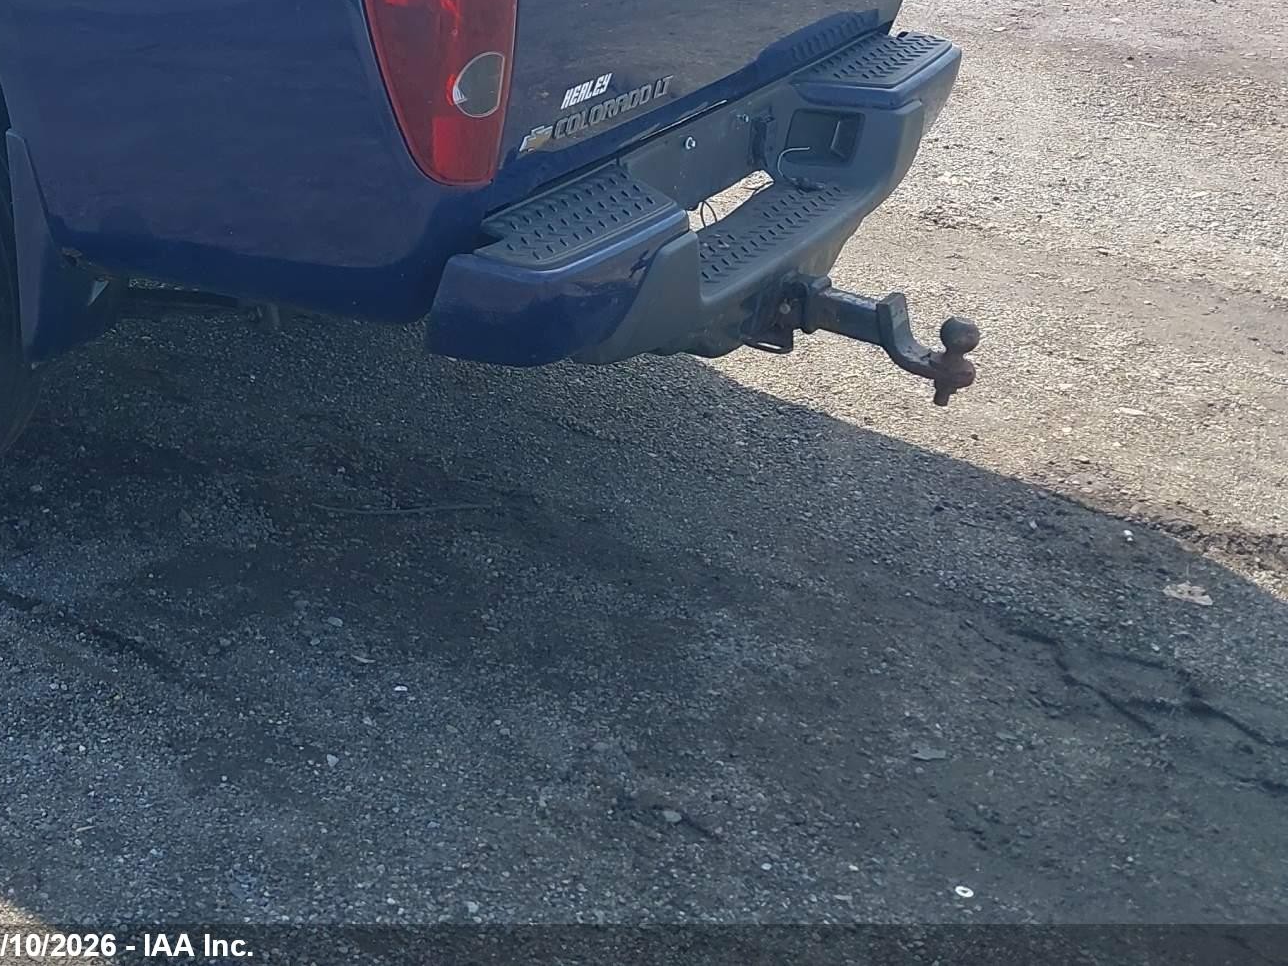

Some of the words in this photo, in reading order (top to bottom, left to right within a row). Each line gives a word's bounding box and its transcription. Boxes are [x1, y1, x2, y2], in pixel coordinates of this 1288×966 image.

[554, 84, 653, 140] COLORADO
[653, 75, 674, 99] LT
[561, 73, 612, 110] HEALEY
